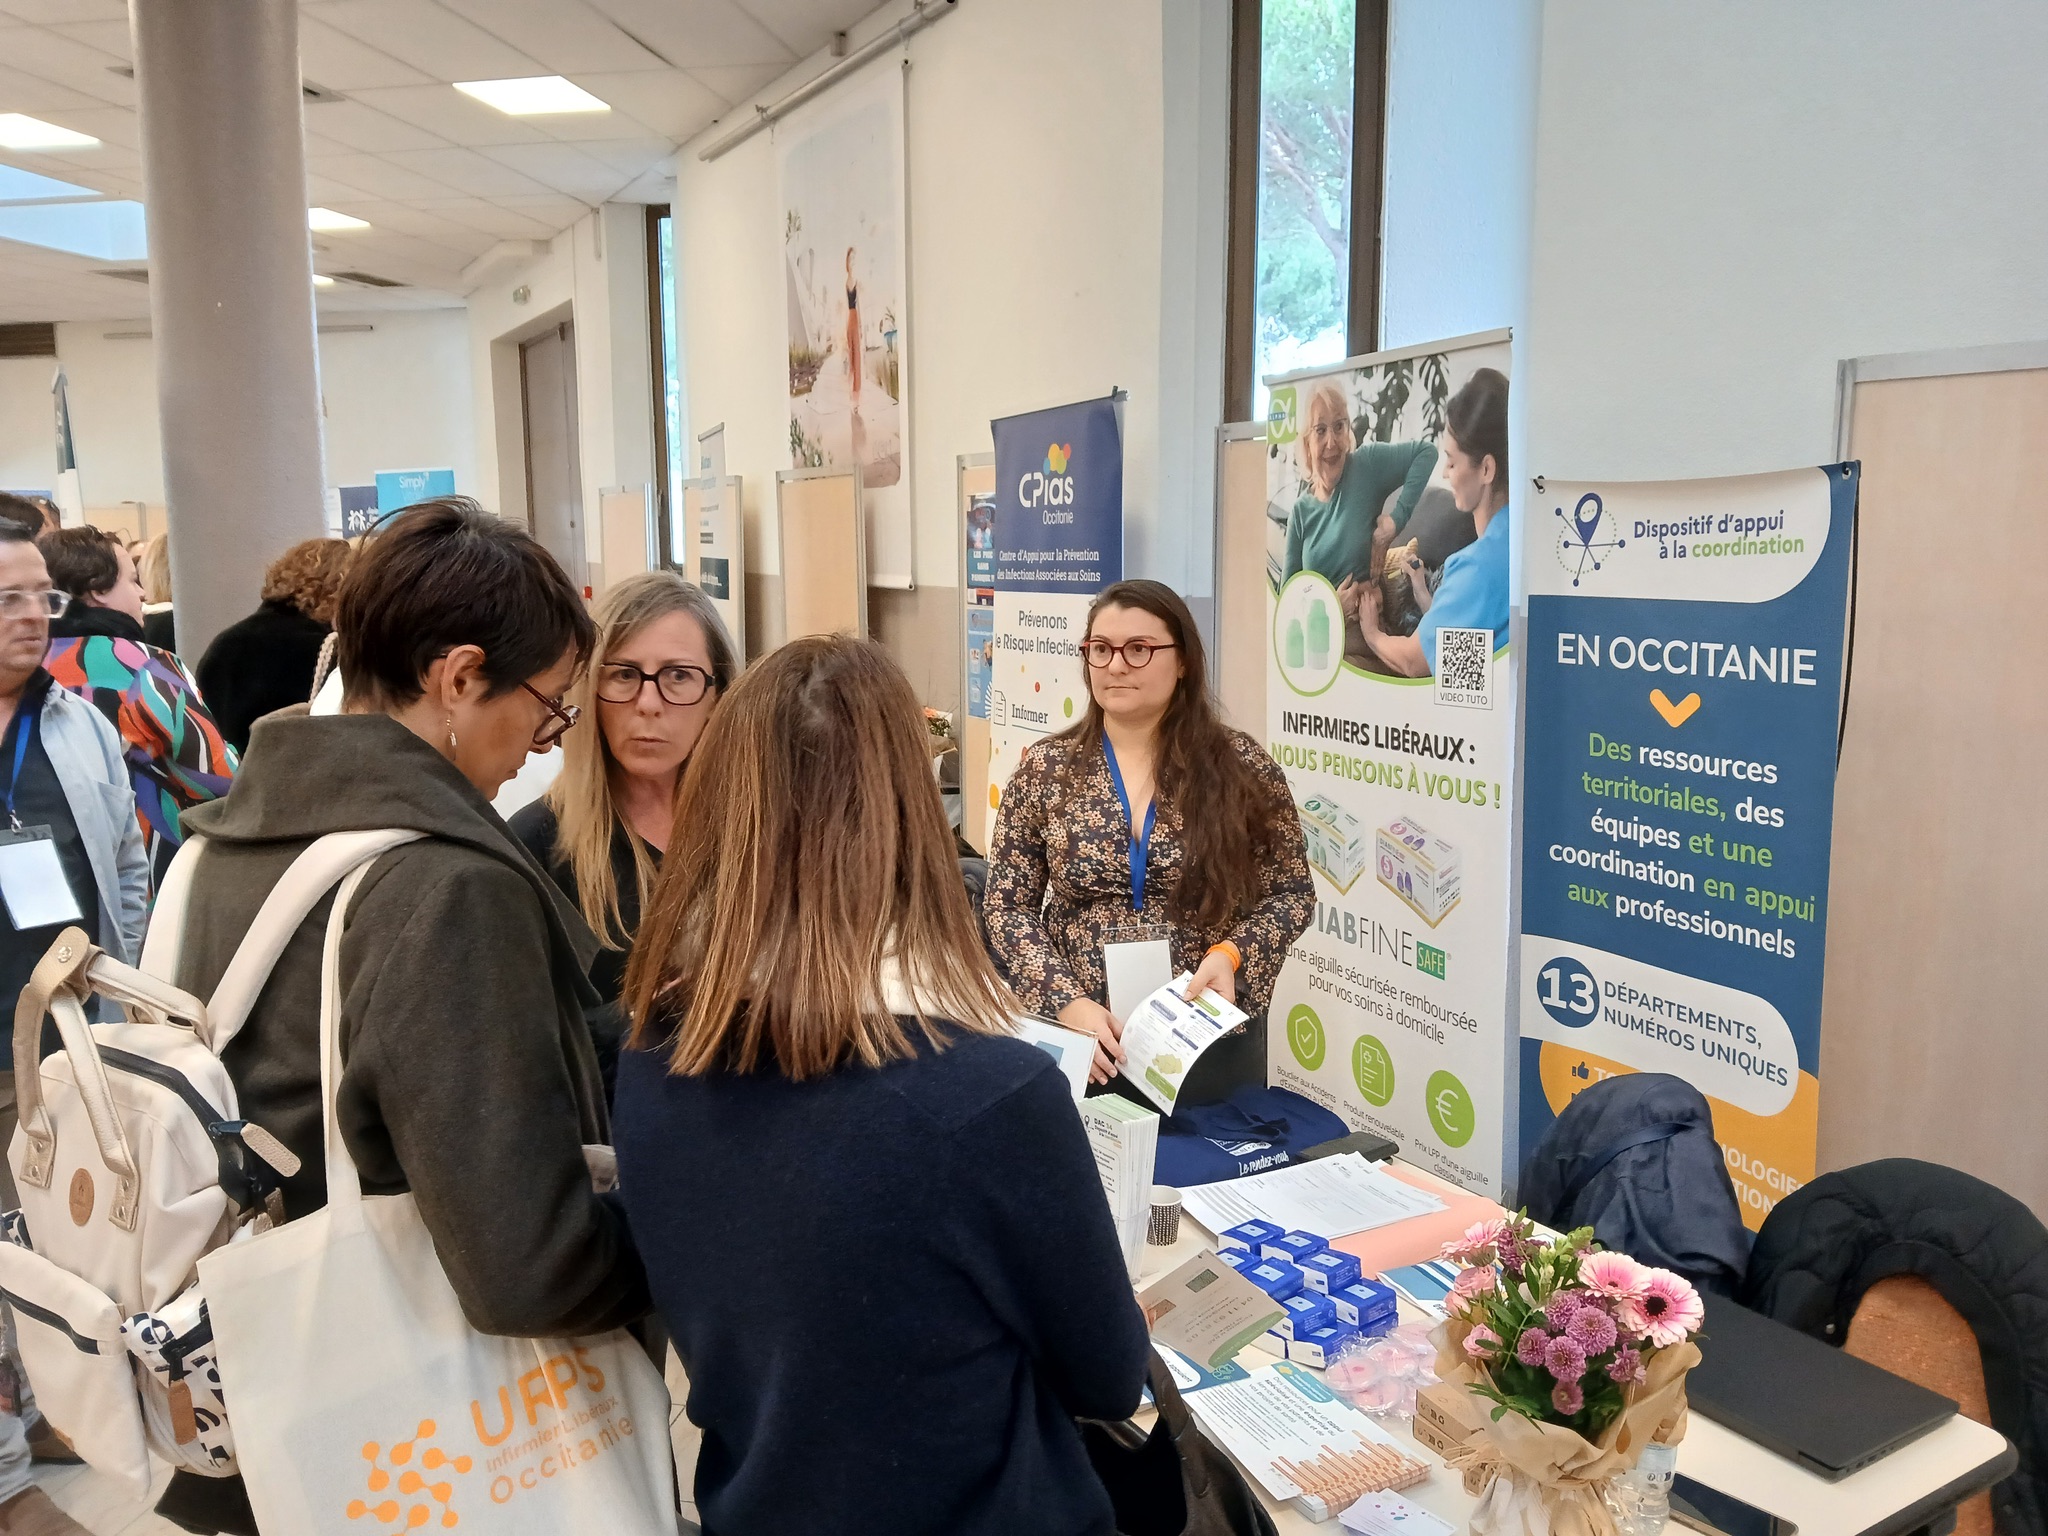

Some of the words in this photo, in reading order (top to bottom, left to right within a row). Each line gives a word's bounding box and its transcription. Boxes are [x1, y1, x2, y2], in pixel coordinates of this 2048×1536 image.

[1042, 509, 1074, 525] Occitanie
[1634, 514, 1713, 542] Dispositif
[1039, 552, 1055, 564] pour
[1056, 548, 1063, 561] la
[1063, 548, 1100, 561] Prévention
[1659, 541, 1668, 559] à
[1673, 540, 1687, 558] la
[1692, 534, 1805, 559] coordination
[1005, 567, 1036, 581] Infections
[1035, 568, 1067, 581] Associées
[1067, 571, 1079, 581] aux
[1079, 568, 1101, 582] Soins
[1003, 633, 1034, 655] Risque
[1036, 636, 1081, 657] Infectieu
[1018, 609, 1068, 630] Prévenons
[1557, 632, 1600, 667] EN
[1608, 636, 1817, 686] OCCITANIE
[1011, 703, 1049, 725] Informer
[1464, 693, 1488, 706] TUTO
[1282, 710, 1371, 746] INFIRMIERS
[1374, 723, 1465, 763] LIBÉRAUX
[1469, 744, 1476, 765] :
[1589, 732, 1632, 762] Des
[1639, 745, 1778, 784] ressources
[1270, 742, 1317, 771] NOUS
[1322, 751, 1403, 790] PENSONS
[1407, 762, 1420, 793] À
[1424, 772, 1487, 806] VOUS
[1493, 783, 1501, 809] !
[1582, 771, 1727, 822] territoriales,
[1735, 796, 1785, 828] des
[1590, 808, 1681, 849] équipes
[1689, 833, 1715, 856] et
[1722, 841, 1773, 867] une
[1549, 843, 1695, 892] coordination
[1703, 876, 1736, 901] en
[1745, 886, 1816, 923] appui
[1309, 902, 1412, 967] IABFINE
[1417, 945, 1445, 977] SAFE
[1567, 883, 1609, 909] aux
[1615, 894, 1796, 959] professionnels
[1286, 944, 1307, 962] Une
[1309, 951, 1343, 977] aiguille
[1345, 966, 1397, 1000] sécurisée
[1400, 988, 1478, 1033] remboursée
[1309, 973, 1334, 993] pour
[1334, 985, 1353, 1004] vos
[1354, 993, 1384, 1017] soins
[1386, 1003, 1393, 1021] à
[1396, 1009, 1445, 1045] domicile
[1541, 967, 1596, 1016] 13
[1604, 980, 1762, 1050] DÉPARTEMENTS,
[1604, 1006, 1696, 1052] NUMÉROS
[1702, 1039, 1789, 1087] UNIQUES
[1276, 1065, 1299, 1083] Bouclier
[1300, 1077, 1311, 1089] aux
[1311, 1082, 1337, 1104] Accidents
[1343, 1100, 1364, 1119] Produit
[1365, 1113, 1405, 1141] renouvelable
[1350, 1117, 1360, 1128] sur
[1249, 1150, 1290, 1173] rendez-vous
[1414, 1138, 1427, 1153] Prix
[1428, 1146, 1440, 1159] LPP
[1440, 1155, 1459, 1172] d'une
[1460, 1166, 1489, 1185] aiguille
[1722, 1143, 1805, 1196] OLOGIE
[490, 1416, 633, 1505] Occitanie
